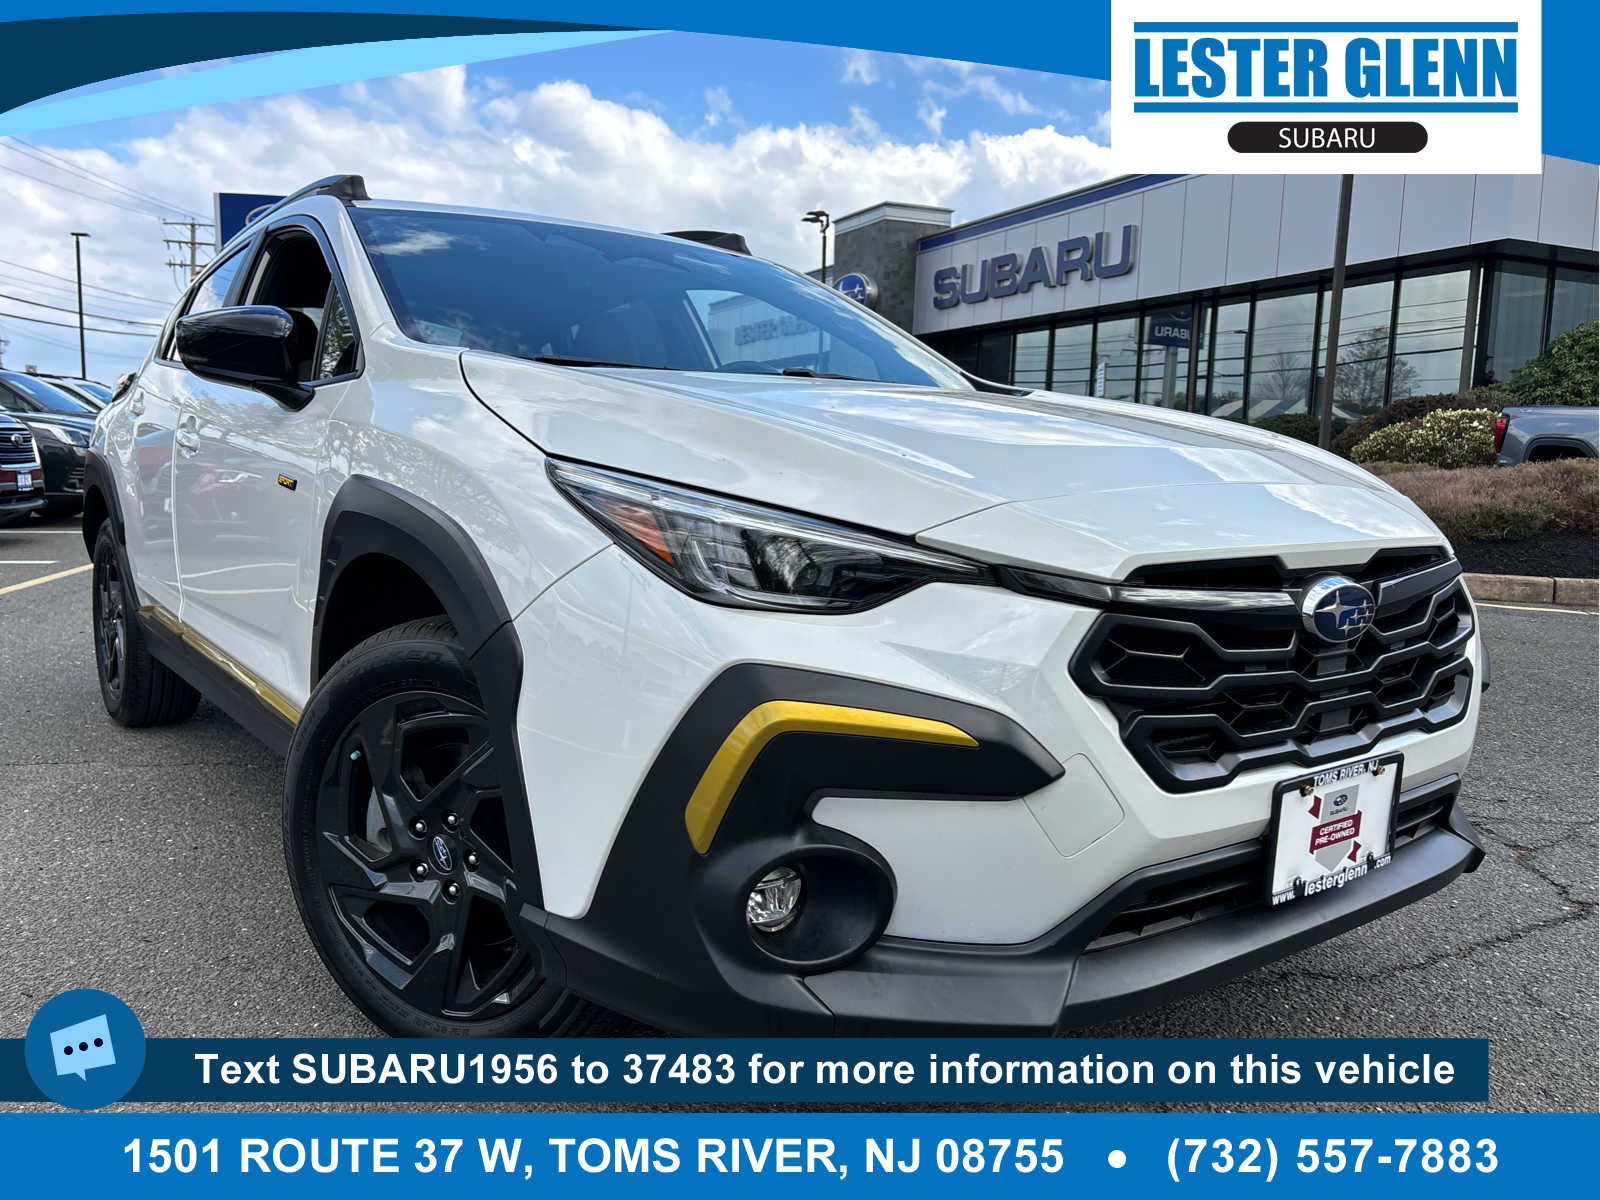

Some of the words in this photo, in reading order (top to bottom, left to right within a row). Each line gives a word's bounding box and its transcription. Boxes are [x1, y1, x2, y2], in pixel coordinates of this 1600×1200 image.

[933, 224, 1138, 310] SUBARU
[1314, 771, 1339, 788] TOMS
[1369, 759, 1380, 773] NJ
[1314, 827, 1356, 846] PRE-OWNED
[1319, 819, 1354, 836] CERTIFIED
[1304, 864, 1368, 897] lesterglenn
